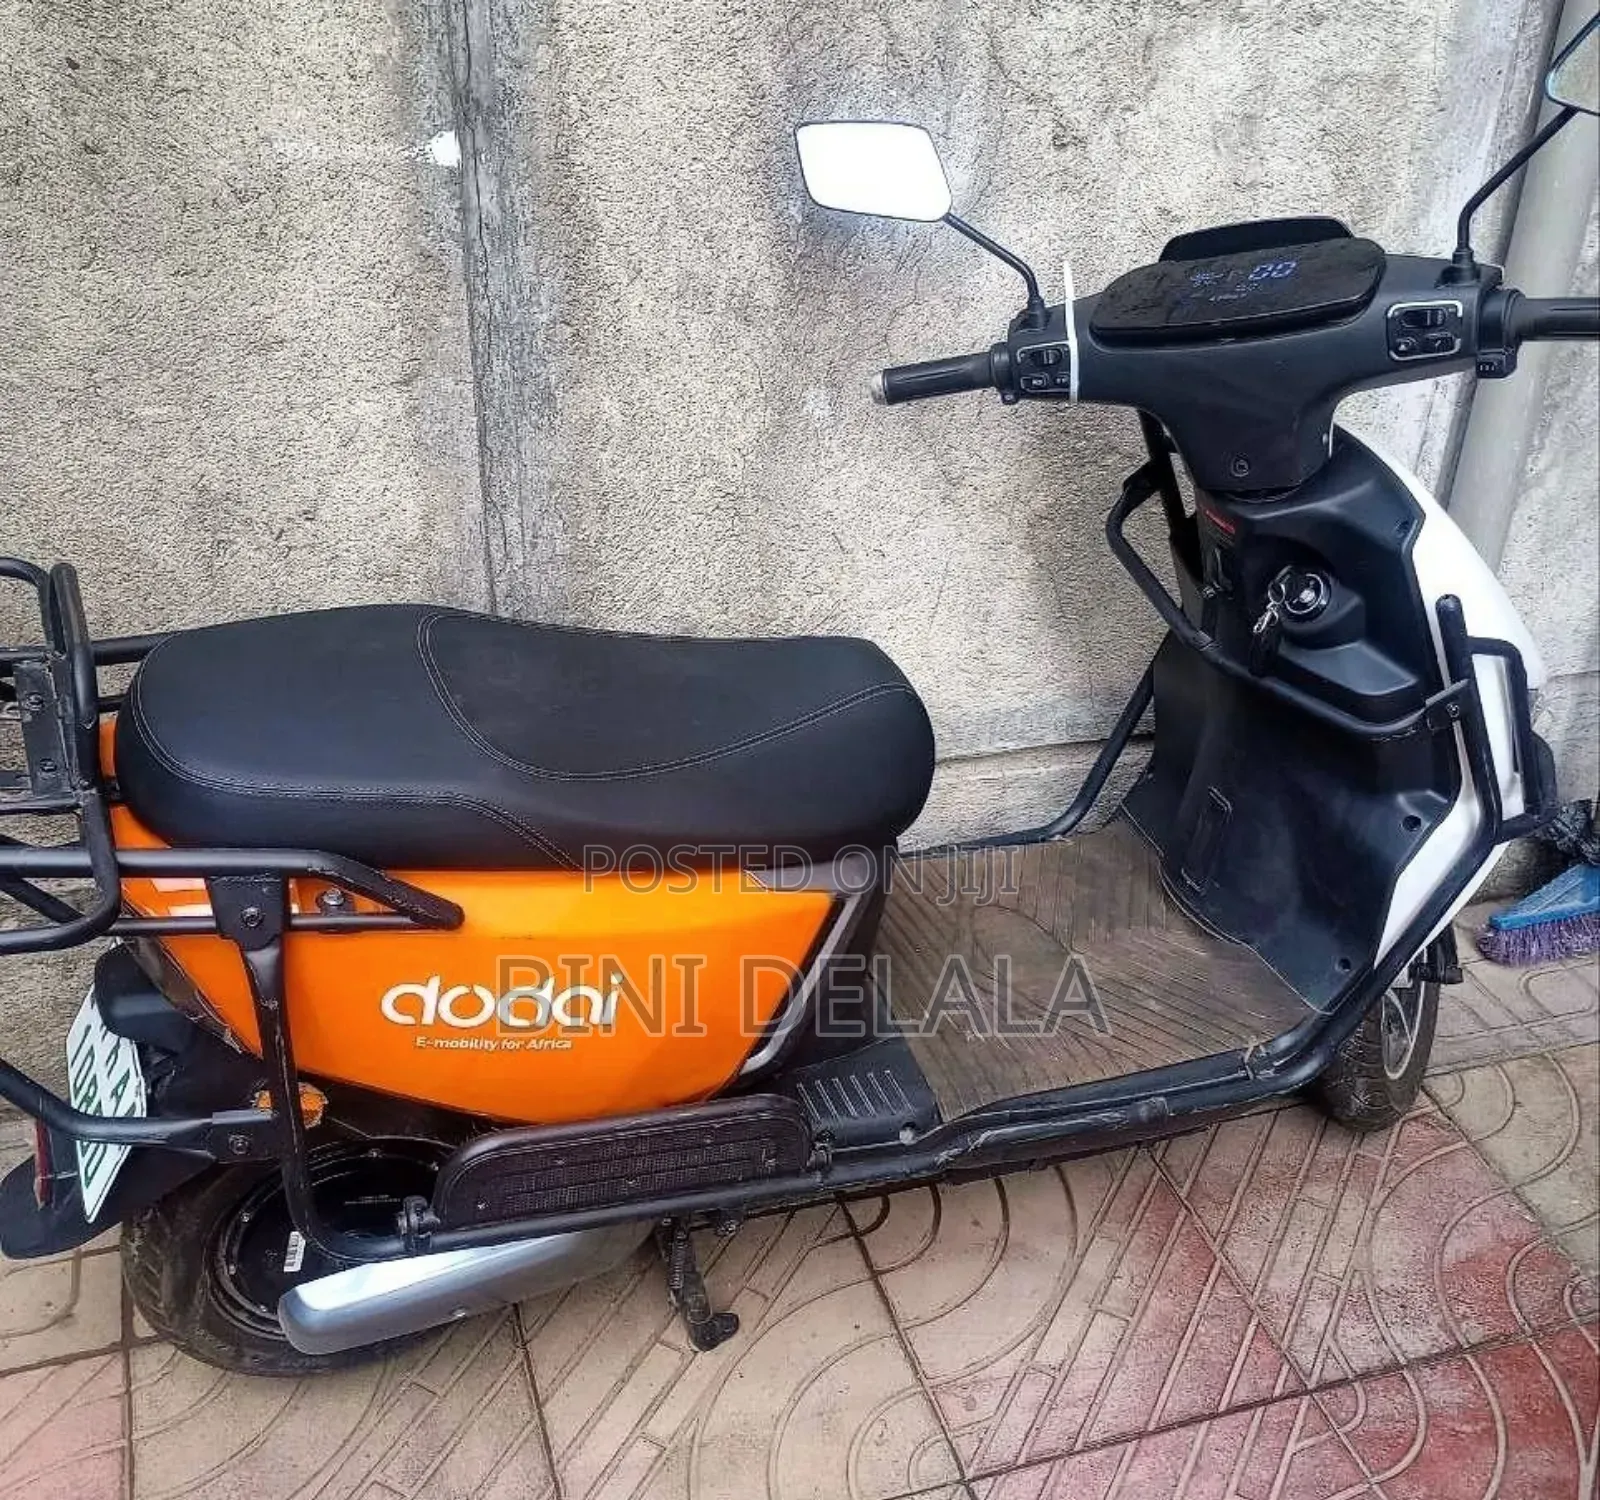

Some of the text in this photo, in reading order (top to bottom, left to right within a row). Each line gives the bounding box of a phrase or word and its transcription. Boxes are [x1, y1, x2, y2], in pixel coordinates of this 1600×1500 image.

[380, 971, 624, 1028] dodai
[415, 1035, 573, 1052] E-mobility for Africa
